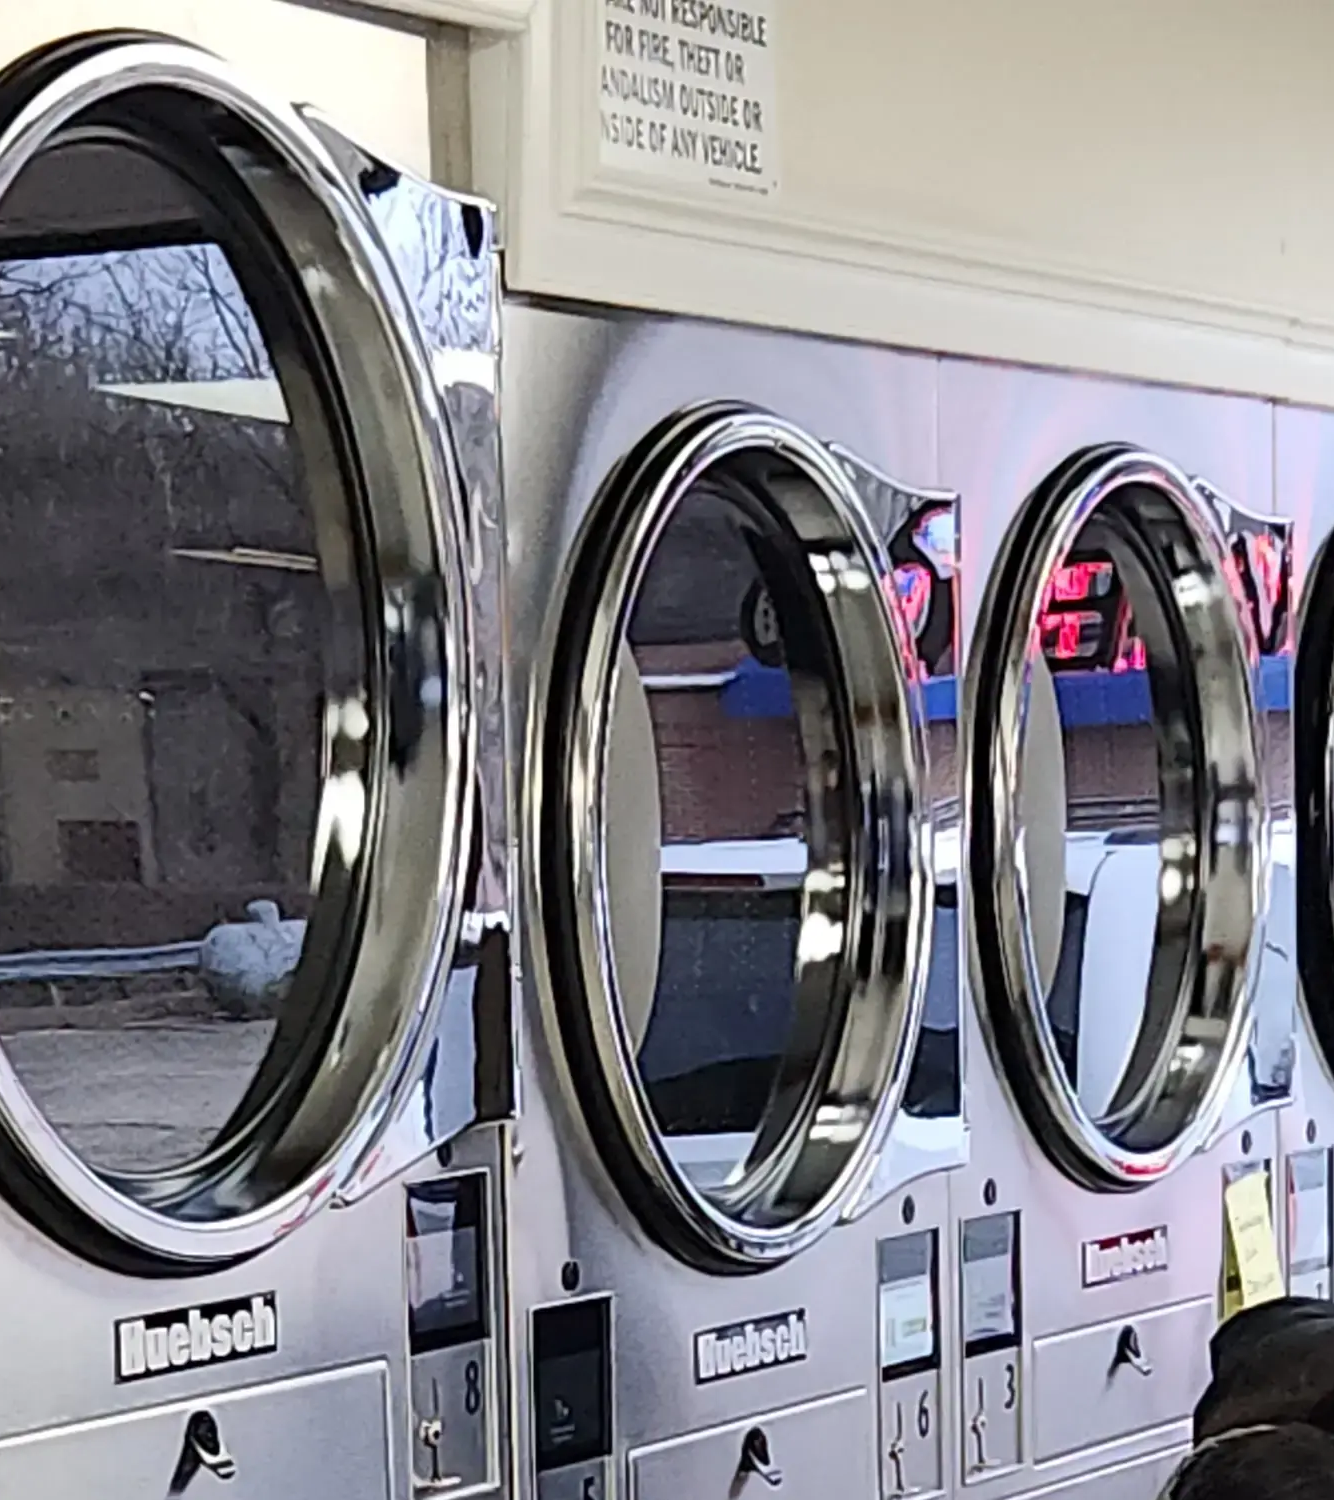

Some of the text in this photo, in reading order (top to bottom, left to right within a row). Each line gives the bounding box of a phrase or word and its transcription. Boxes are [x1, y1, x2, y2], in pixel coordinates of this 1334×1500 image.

[605, 20, 745, 86] FOR FIRE, THEFT OR
[671, 0, 767, 47] RESPONSIBLE
[600, 64, 764, 133] ANDALISM OUTSIDE OR
[600, 110, 764, 175] NSIDE OF ANY VEHICLE.
[119, 1295, 276, 1377] Huebsch
[697, 1313, 806, 1379] Huebsch
[464, 1360, 481, 1415] 8
[918, 1390, 929, 1437] 6
[1005, 1363, 1016, 1409] 3
